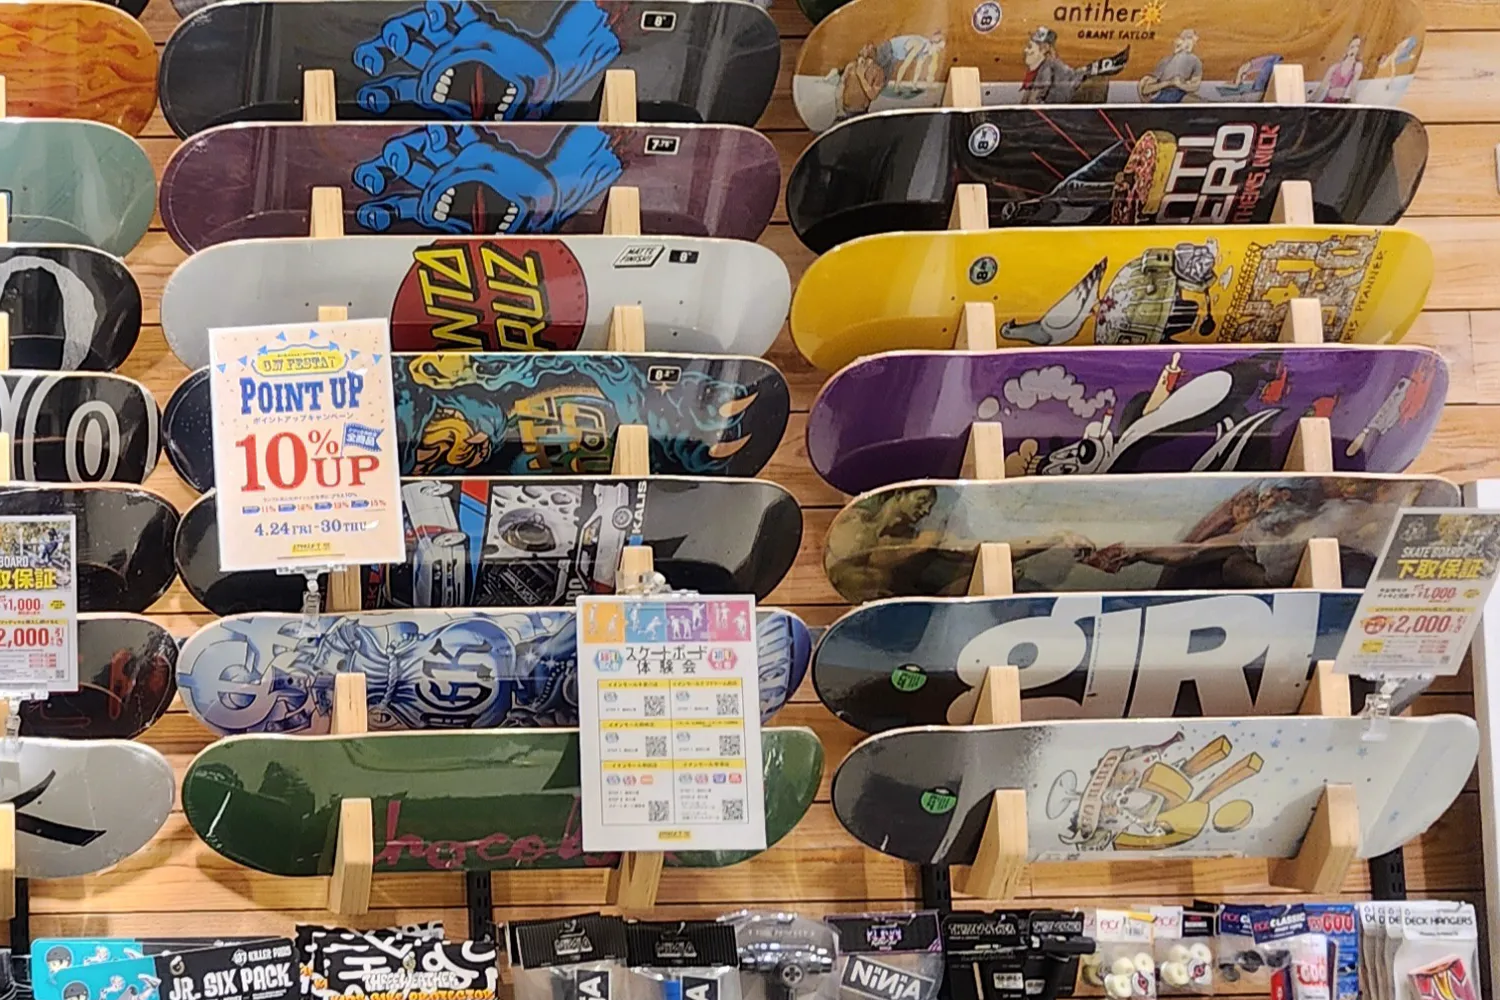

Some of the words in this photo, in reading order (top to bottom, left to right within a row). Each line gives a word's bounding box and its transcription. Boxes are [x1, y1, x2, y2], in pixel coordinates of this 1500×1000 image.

[1077, 30, 1115, 39] GRANT
[480, 246, 549, 350] RUZ
[239, 376, 324, 415] POINT
[330, 371, 364, 410] UP
[252, 411, 354, 425] ポイントアップキャンペーン
[631, 481, 648, 534] KALIS
[1400, 546, 1429, 558] SKATE
[1396, 558, 1484, 581] 下取保証
[1387, 615, 1452, 633] ¥2,000
[625, 644, 707, 661] スケートボード
[636, 659, 697, 675] 体験会
[1269, 913, 1307, 930] CLASSIC
[1404, 916, 1428, 927] DECK
[1430, 915, 1473, 926] HANGERS
[204, 970, 239, 998] SIX
[241, 962, 294, 993] PACK
